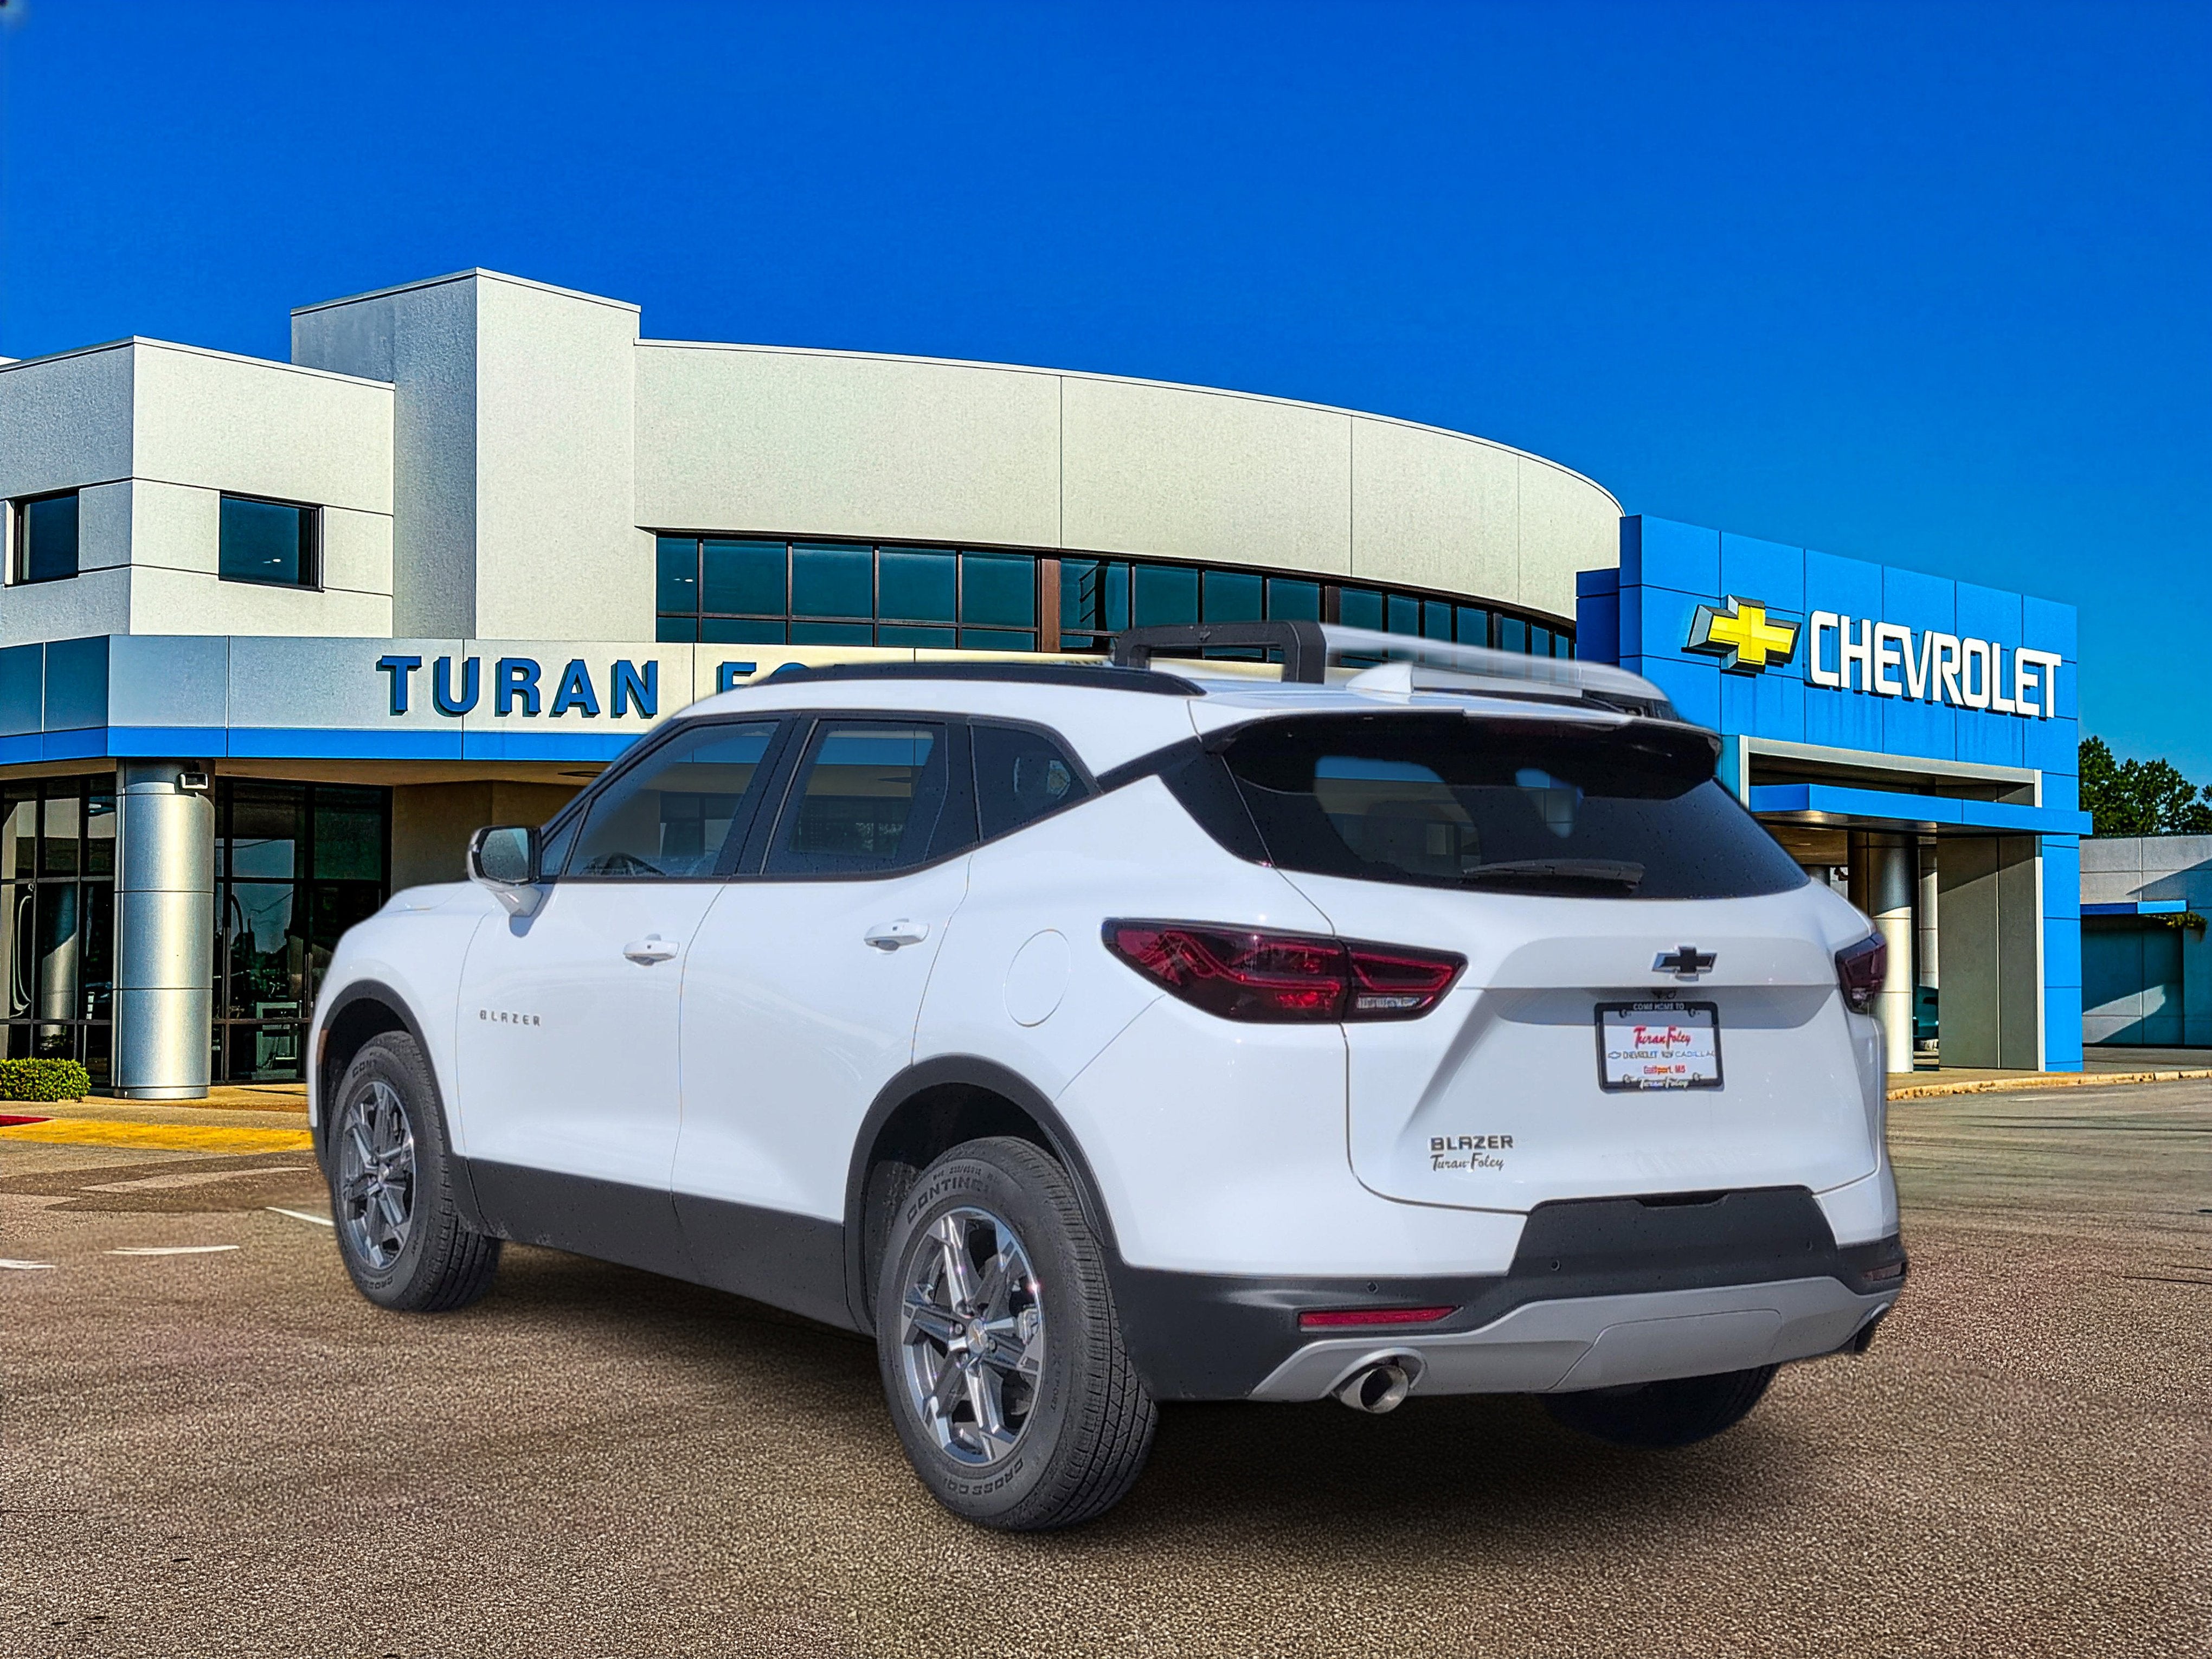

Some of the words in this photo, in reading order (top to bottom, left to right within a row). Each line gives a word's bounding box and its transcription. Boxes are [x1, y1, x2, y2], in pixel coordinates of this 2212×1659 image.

[1809, 610, 2062, 719] CHEVROLET
[376, 654, 659, 719] TURAN
[480, 1009, 541, 1026] BLAZER
[1431, 1135, 1514, 1150] BLAZER
